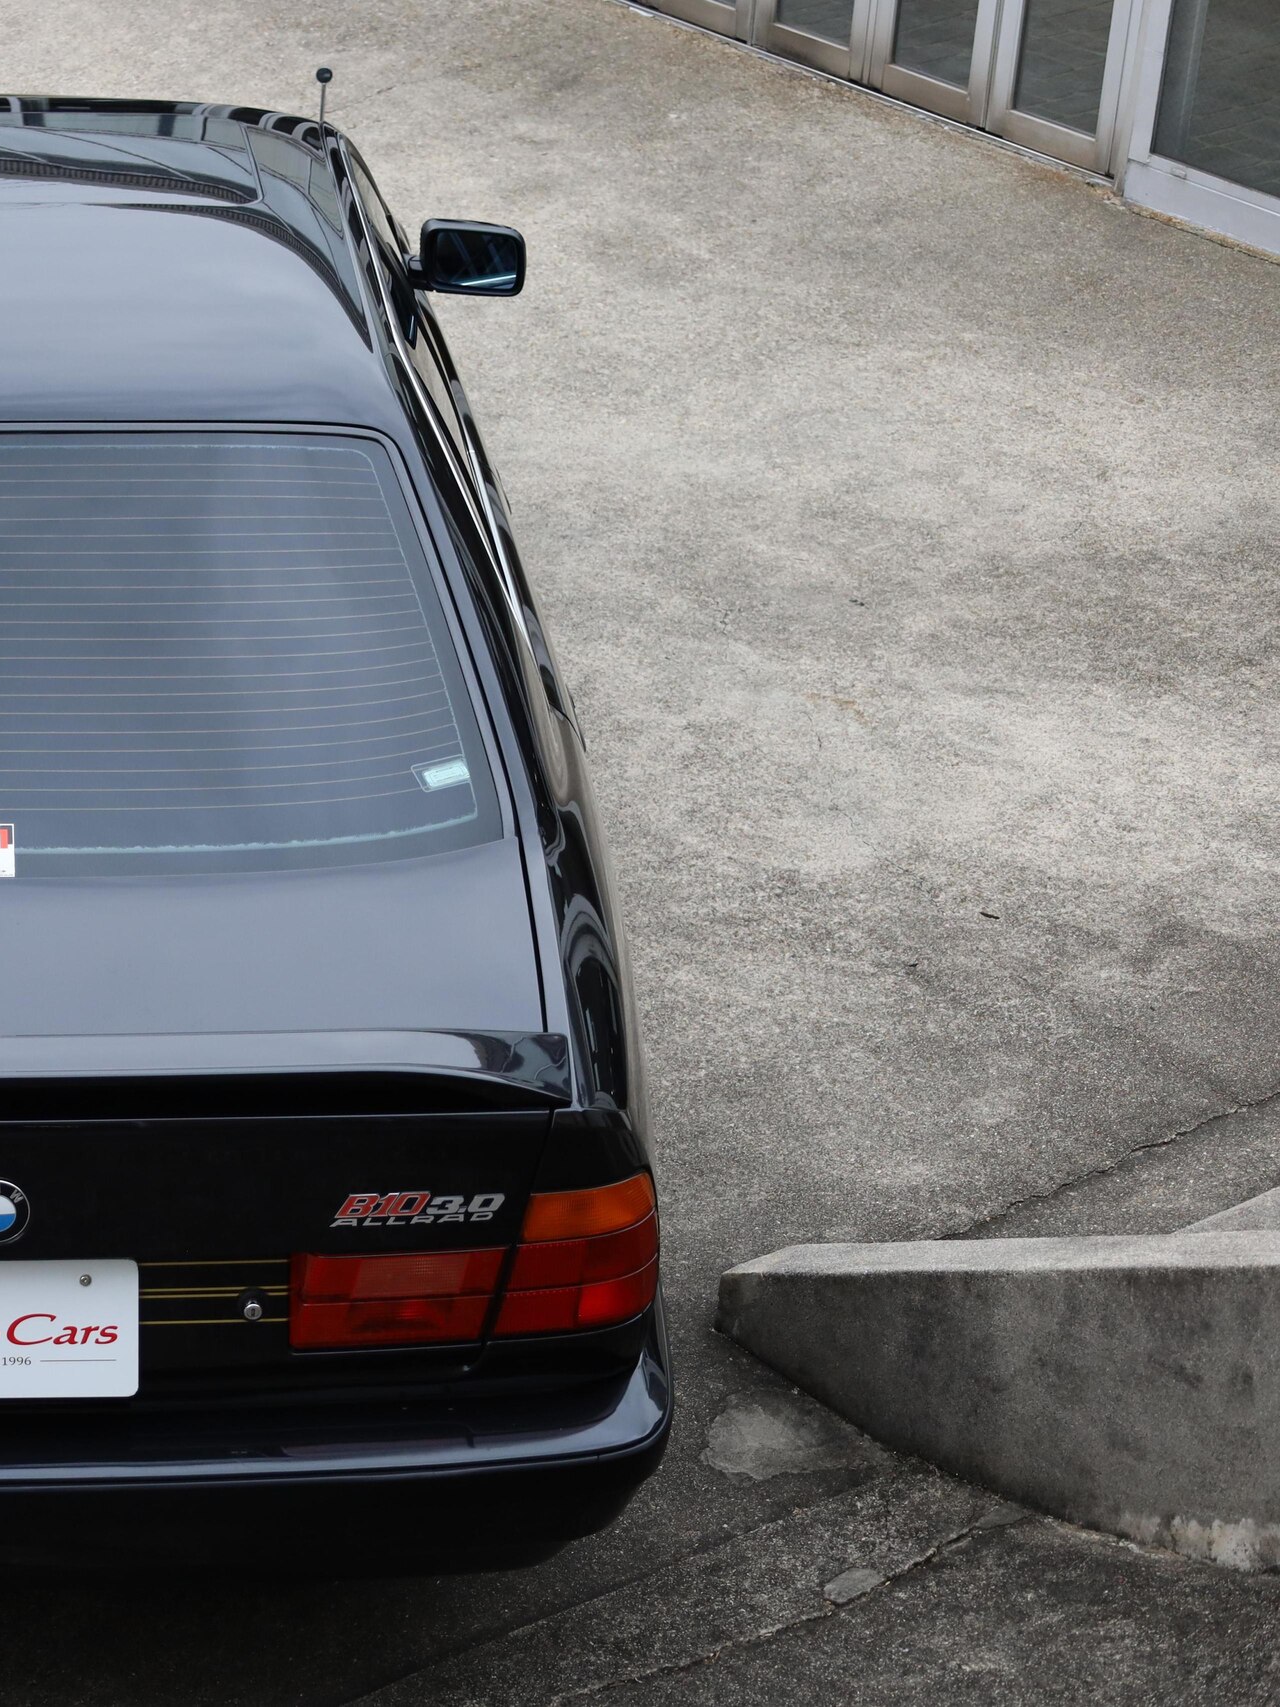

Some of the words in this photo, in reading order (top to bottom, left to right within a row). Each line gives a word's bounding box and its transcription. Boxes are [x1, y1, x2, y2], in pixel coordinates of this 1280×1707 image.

[334, 1191, 431, 1219] B10
[425, 1193, 506, 1215] 3.0
[329, 1212, 493, 1227] ALLRAD
[6, 1313, 119, 1346] Cars
[2, 1356, 32, 1366] 1996
